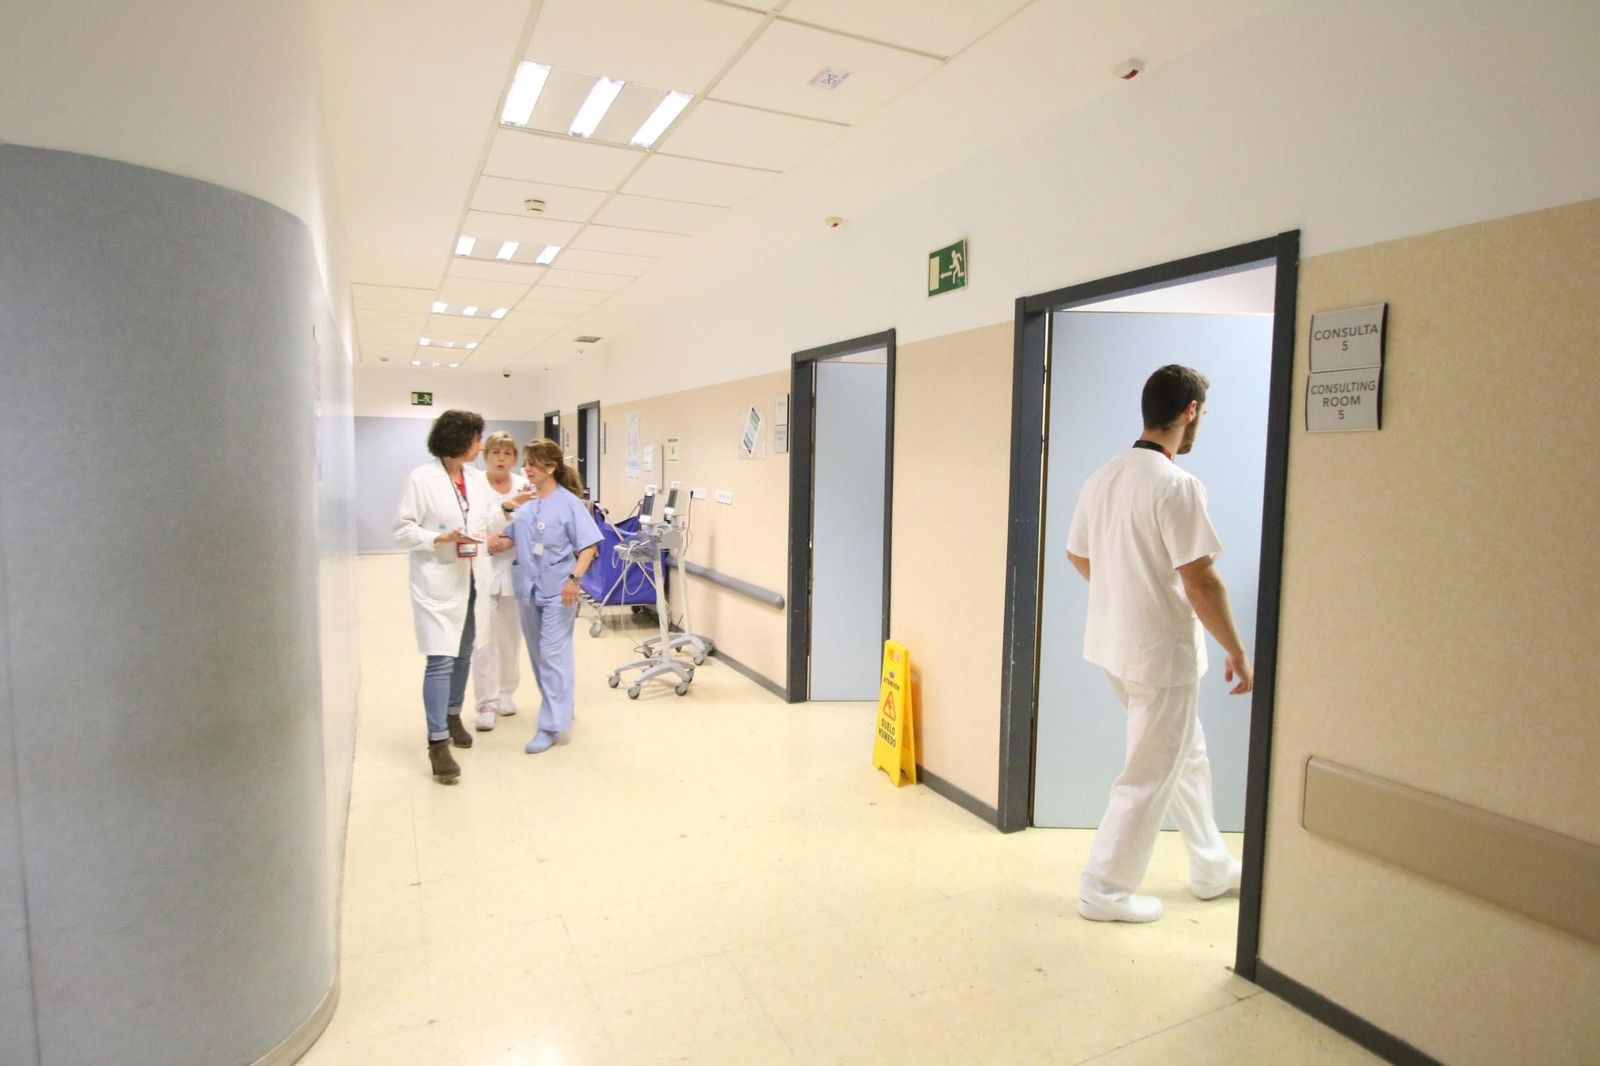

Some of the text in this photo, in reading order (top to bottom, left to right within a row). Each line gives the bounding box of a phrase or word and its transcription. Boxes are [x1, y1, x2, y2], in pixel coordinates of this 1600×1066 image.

[1314, 324, 1378, 341] CONSULTA
[1342, 341, 1348, 351] 5
[1311, 381, 1376, 395] CONSULTING
[1322, 396, 1361, 407] ROOM
[1338, 410, 1345, 420] 5
[881, 718, 896, 736] SUELO
[878, 727, 897, 748] HUMEDO
